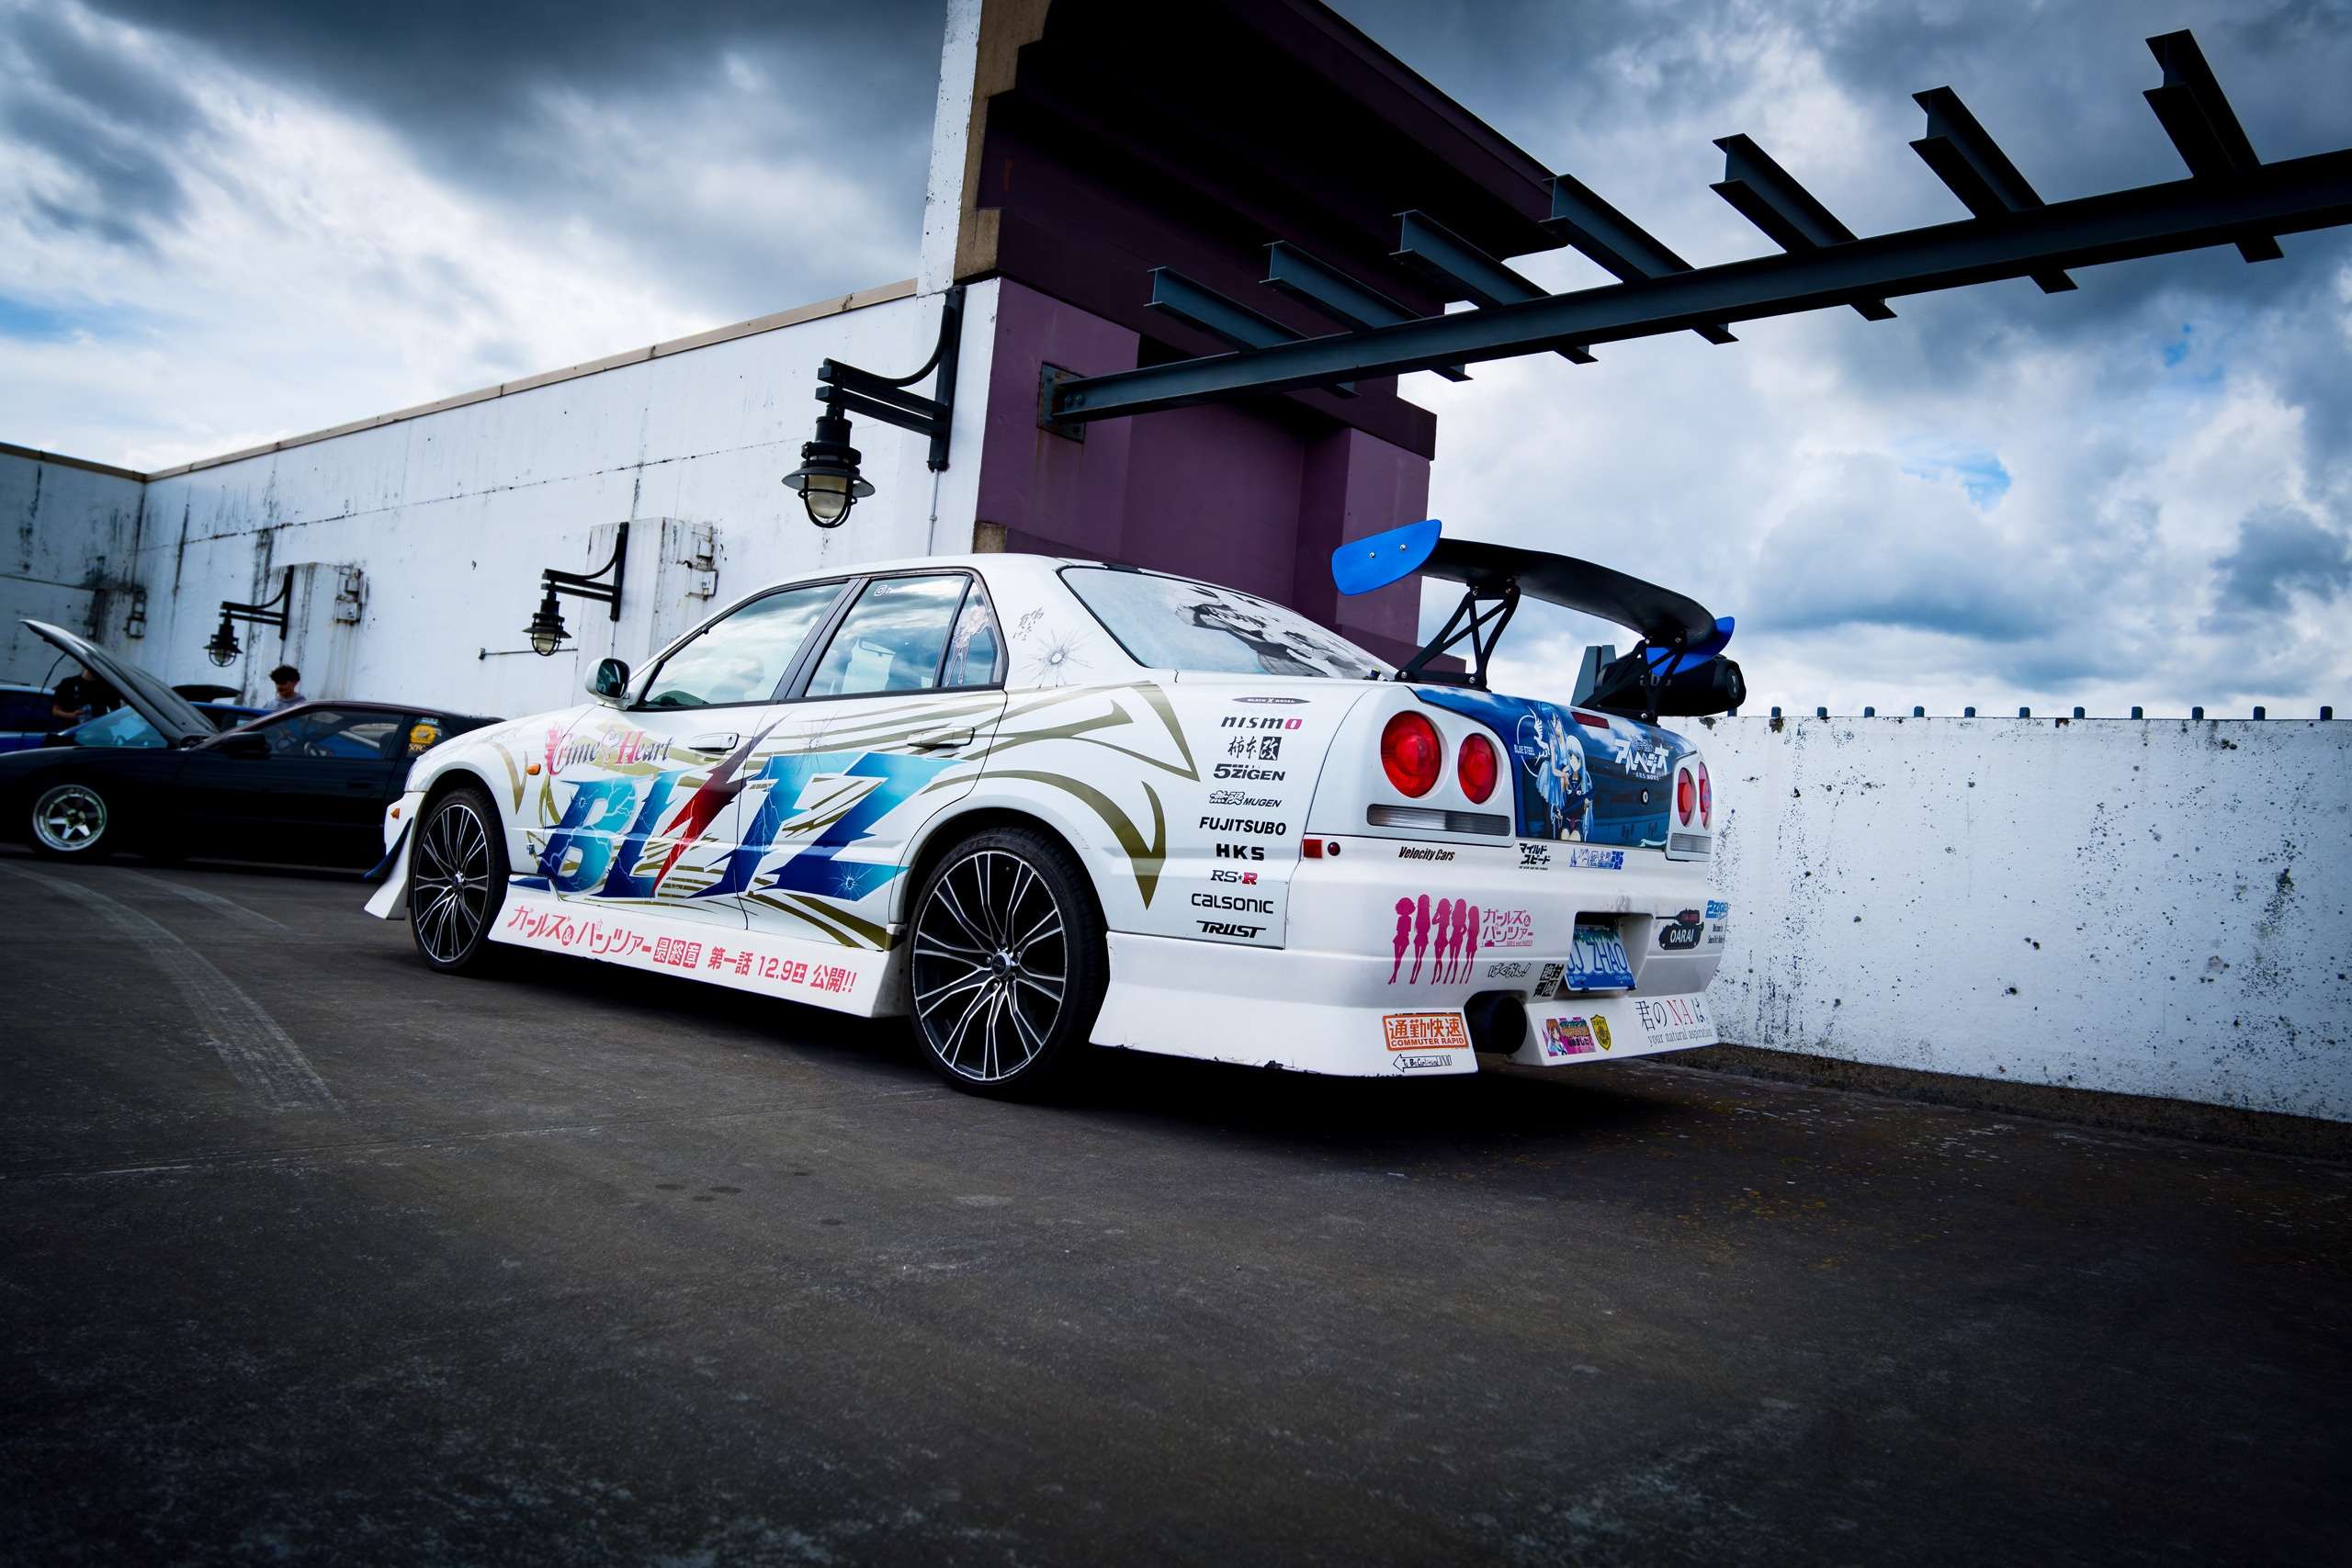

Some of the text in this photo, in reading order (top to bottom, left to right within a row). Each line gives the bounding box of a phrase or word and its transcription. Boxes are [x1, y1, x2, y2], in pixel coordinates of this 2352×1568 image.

[545, 720, 674, 776] Crime Heart
[1227, 736, 1282, 761] 柿本改
[535, 710, 972, 903] BLITZ
[1209, 790, 1282, 807] 無限 MUGEN
[1199, 817, 1286, 836] FUJITSUBO
[1216, 843, 1264, 861] HKS
[1398, 846, 1455, 862] Velocity Cars
[1519, 842, 1548, 855] マイルド
[1521, 853, 1551, 865] スピード
[1196, 919, 1267, 939] TRUST
[1482, 922, 1533, 942] パンツァー
[1669, 929, 1695, 943] OARAI
[707, 946, 753, 976] 第一話
[1586, 942, 1627, 972] ZHAO
[1387, 1017, 1463, 1040] 通勤快速
[1647, 1027, 1713, 1047] your natural aspiration
[1391, 1038, 1440, 1047] COMMUTER
